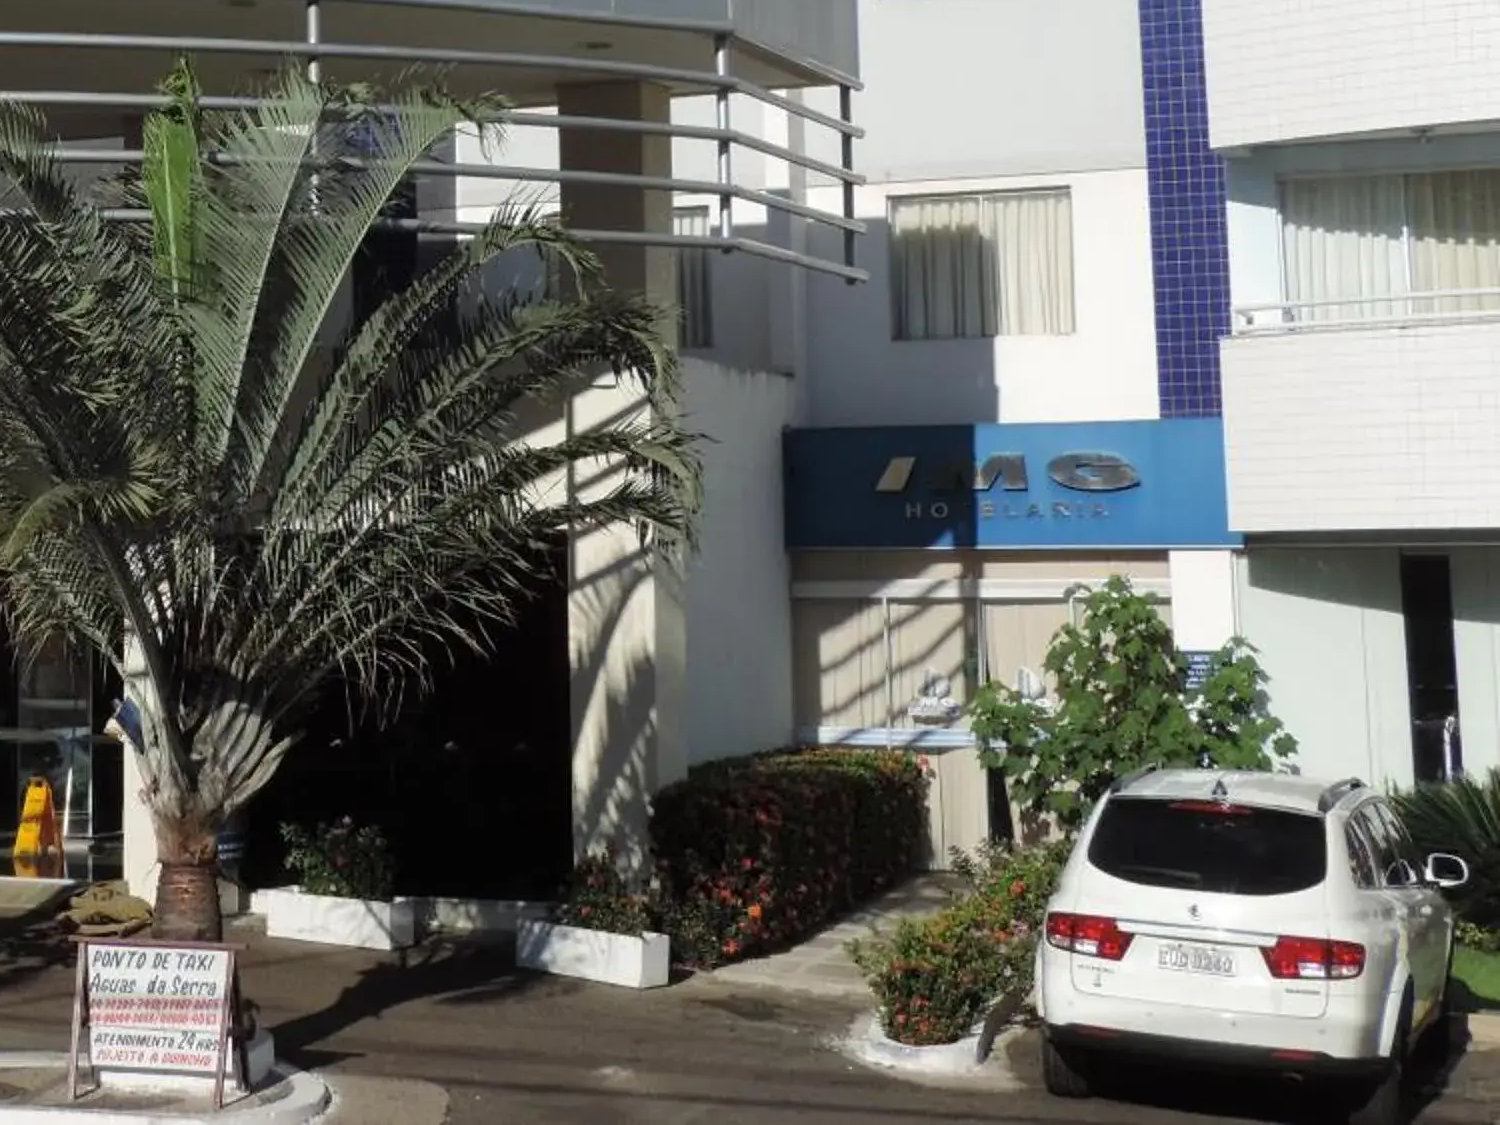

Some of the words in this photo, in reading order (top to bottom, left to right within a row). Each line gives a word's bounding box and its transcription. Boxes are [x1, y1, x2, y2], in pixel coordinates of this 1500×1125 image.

[92, 949, 147, 970] PONTO
[152, 952, 172, 970] DE
[176, 953, 216, 972] TAXI
[147, 974, 166, 995] da
[171, 974, 218, 997] Serra
[177, 1030, 196, 1050] 24
